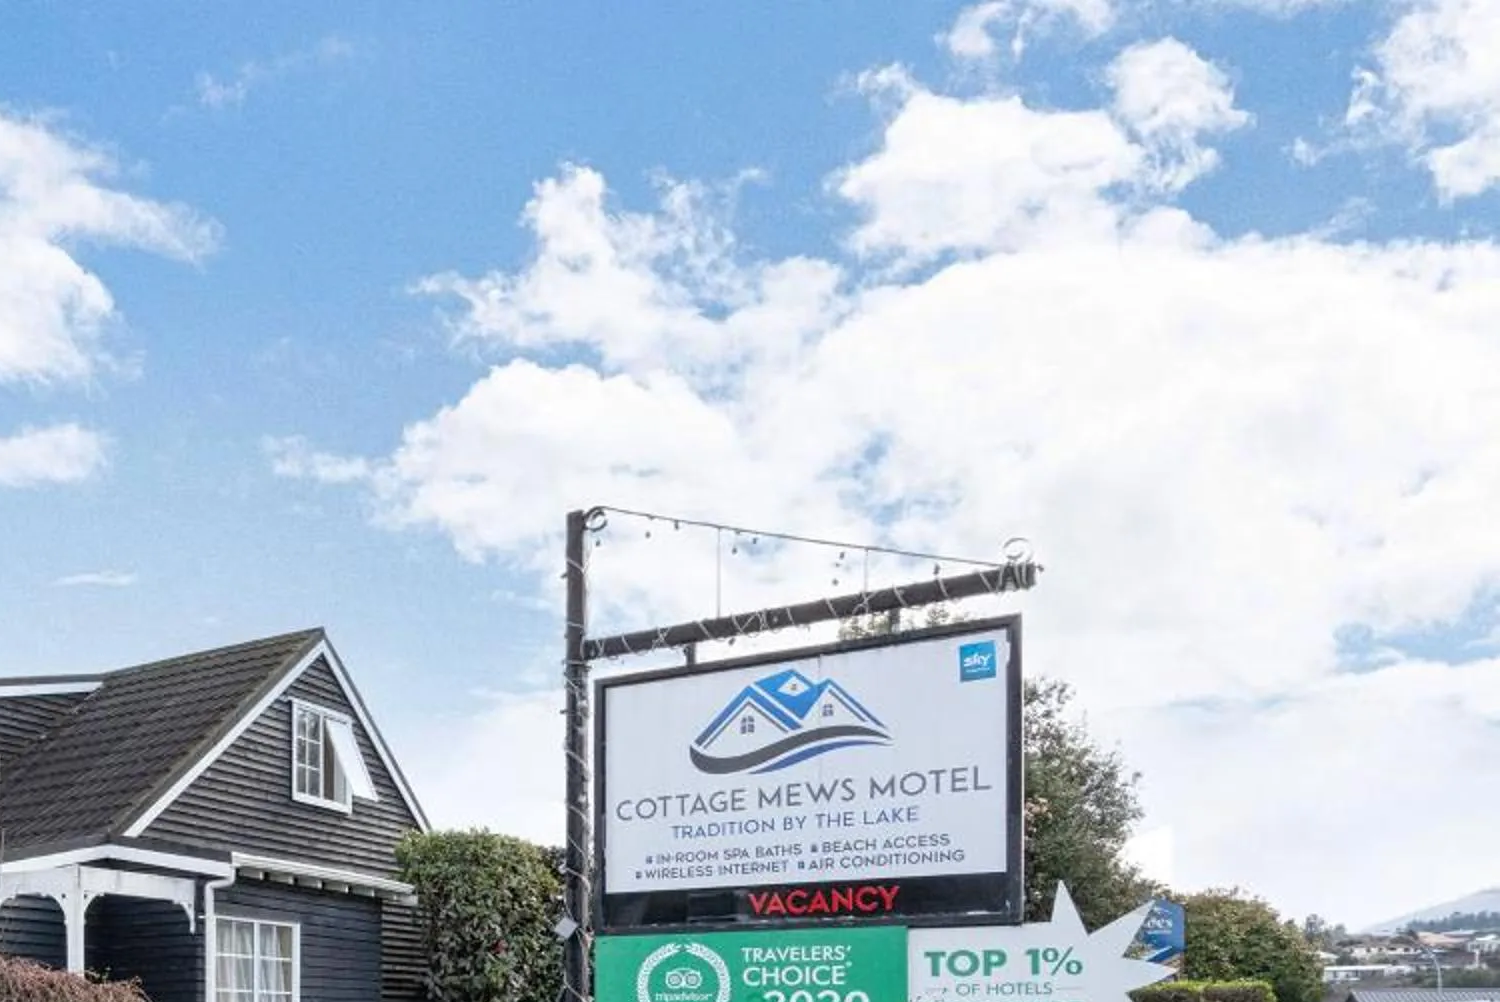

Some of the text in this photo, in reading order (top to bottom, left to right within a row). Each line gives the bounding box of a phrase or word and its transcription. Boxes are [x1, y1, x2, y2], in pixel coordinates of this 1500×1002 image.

[616, 765, 992, 821] COTTAGE MEWS MOTEL
[671, 805, 920, 839] TRADITION BY THE LAKE
[645, 849, 966, 880] WIRELESS INTERNET AIR CONDITIONING
[656, 833, 951, 865] IN-ROOM SPA BATHS BEACH ACCESS
[749, 885, 900, 915] VACANCY
[924, 945, 1084, 977] TOP 1%
[955, 981, 1053, 996] OF HOTELS
